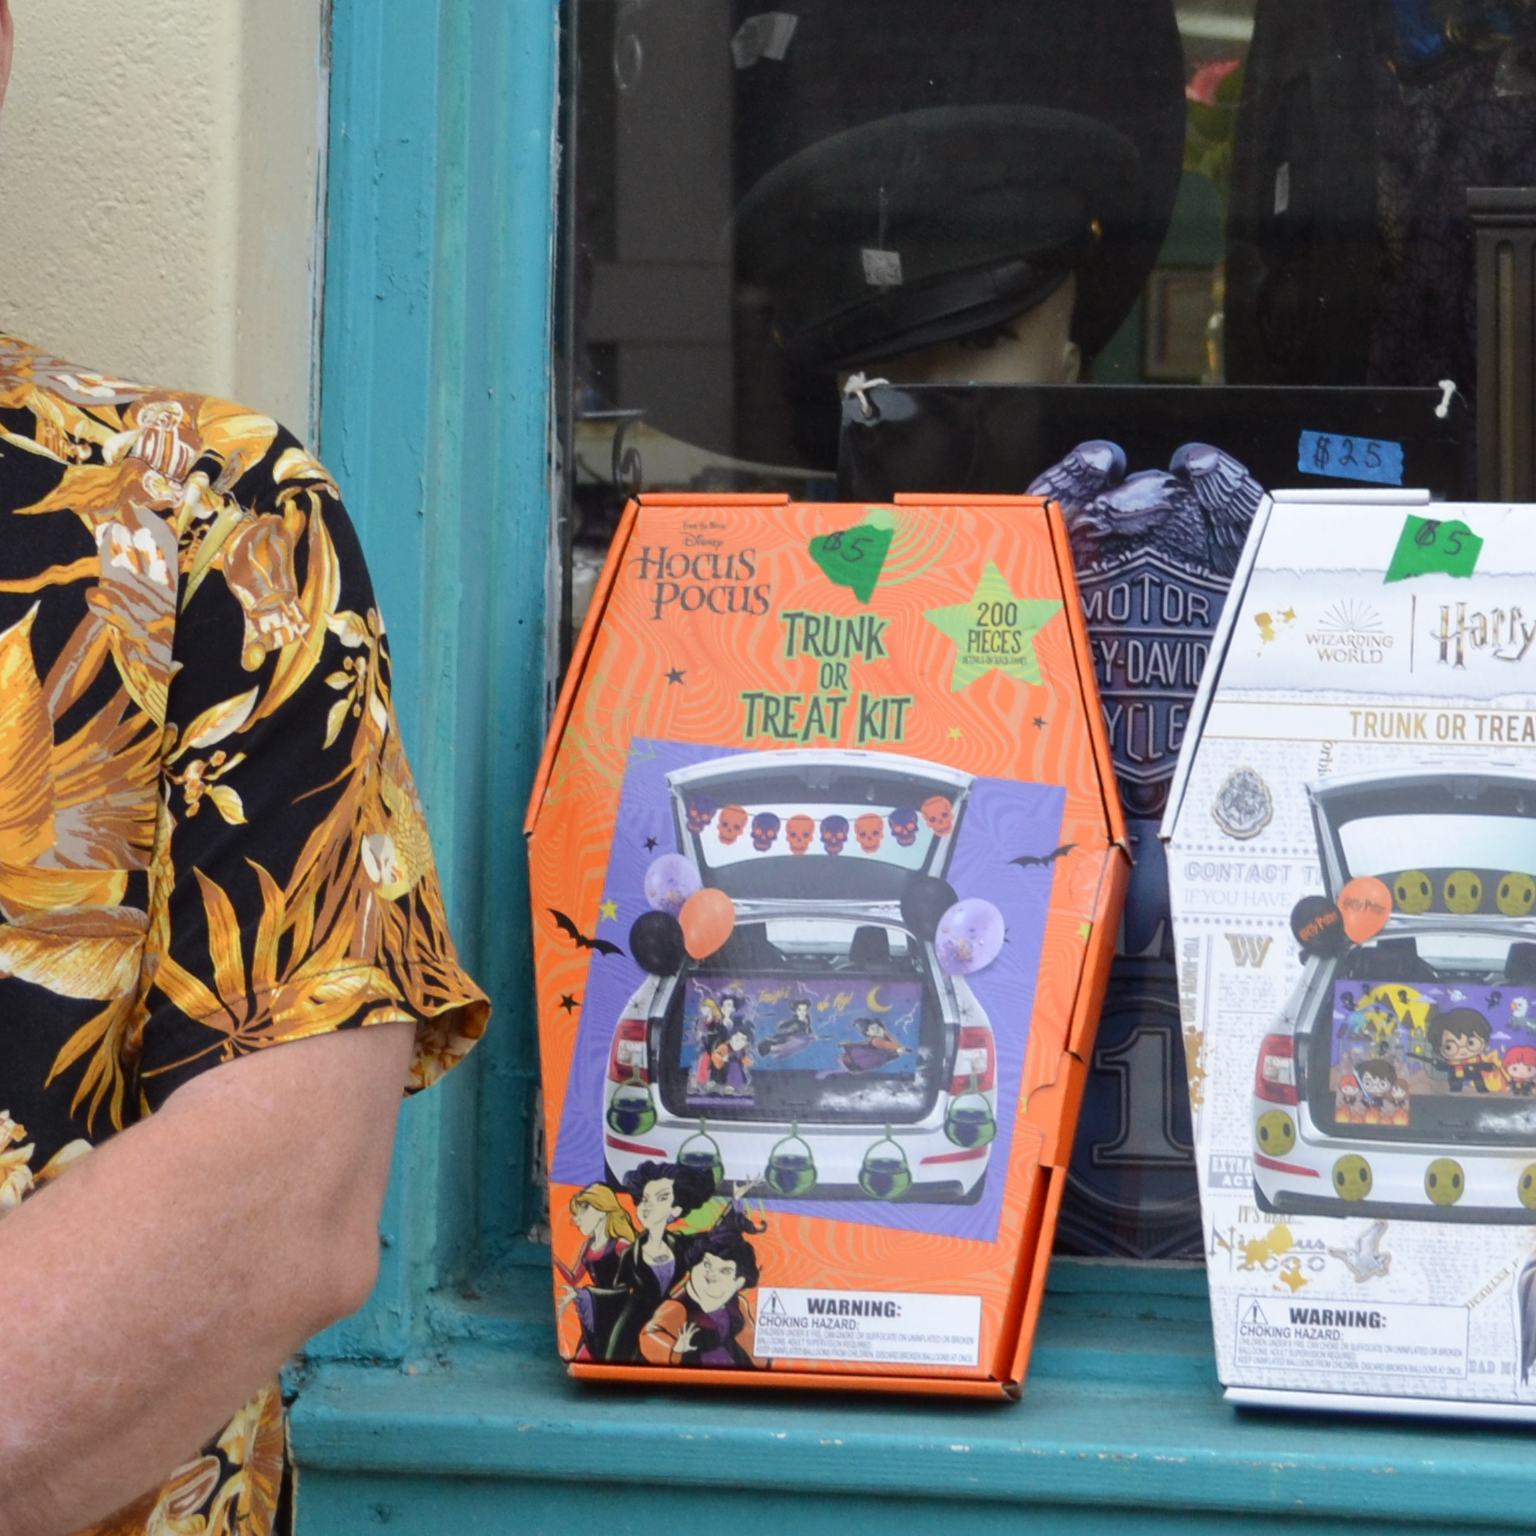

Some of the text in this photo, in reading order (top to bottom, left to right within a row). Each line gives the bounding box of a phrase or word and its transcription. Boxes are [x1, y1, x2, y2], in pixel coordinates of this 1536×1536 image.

[1313, 436, 1382, 469] $25
[680, 531, 724, 551] Disney
[630, 546, 756, 581] HOCUS
[650, 582, 771, 621] POCUS
[976, 602, 1017, 627] 200
[781, 612, 887, 661] TRUNK
[967, 629, 1022, 654] PIECES
[1305, 632, 1395, 651] WIZARDING
[1316, 647, 1384, 665] WORLD
[820, 662, 848, 691] OR
[741, 692, 912, 743] TREAT KIT
[1349, 710, 1428, 740] TRUNK
[1436, 713, 1467, 741] OR
[1184, 861, 1293, 885] CONTACT
[1225, 933, 1274, 968] W
[806, 1296, 901, 1319] WARNING:
[1289, 1307, 1388, 1330] WARNING:
[758, 1317, 859, 1331] CHOKING HAZARD:
[1239, 1327, 1344, 1342] CHOKING HAZARD:
